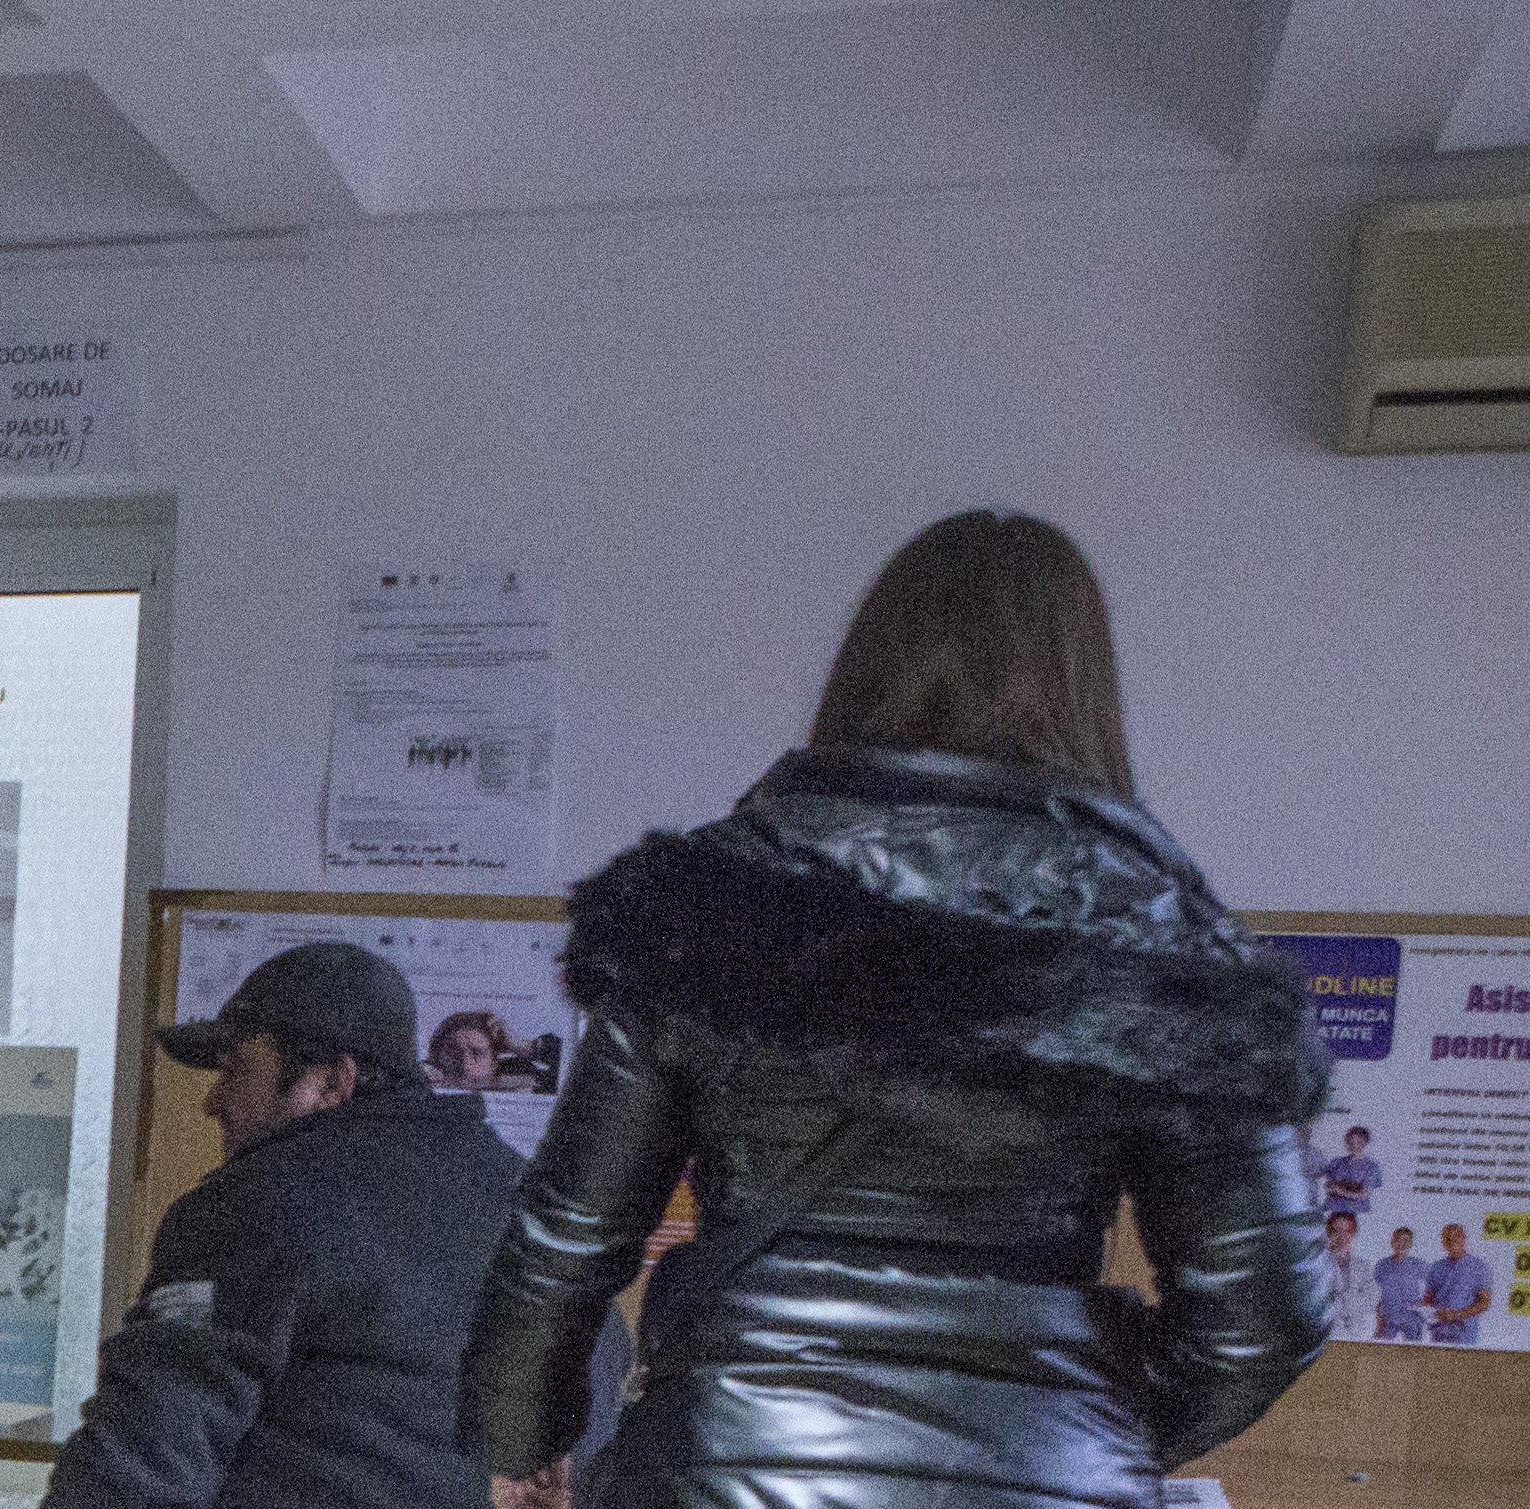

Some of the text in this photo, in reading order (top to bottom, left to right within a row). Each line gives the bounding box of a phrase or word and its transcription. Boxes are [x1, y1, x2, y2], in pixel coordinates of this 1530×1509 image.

[82, 340, 111, 361] DE
[11, 378, 85, 401] SOMAJ
[80, 416, 94, 436] 2
[1465, 984, 1530, 1013] Asis
[1483, 1217, 1519, 1235] CV
